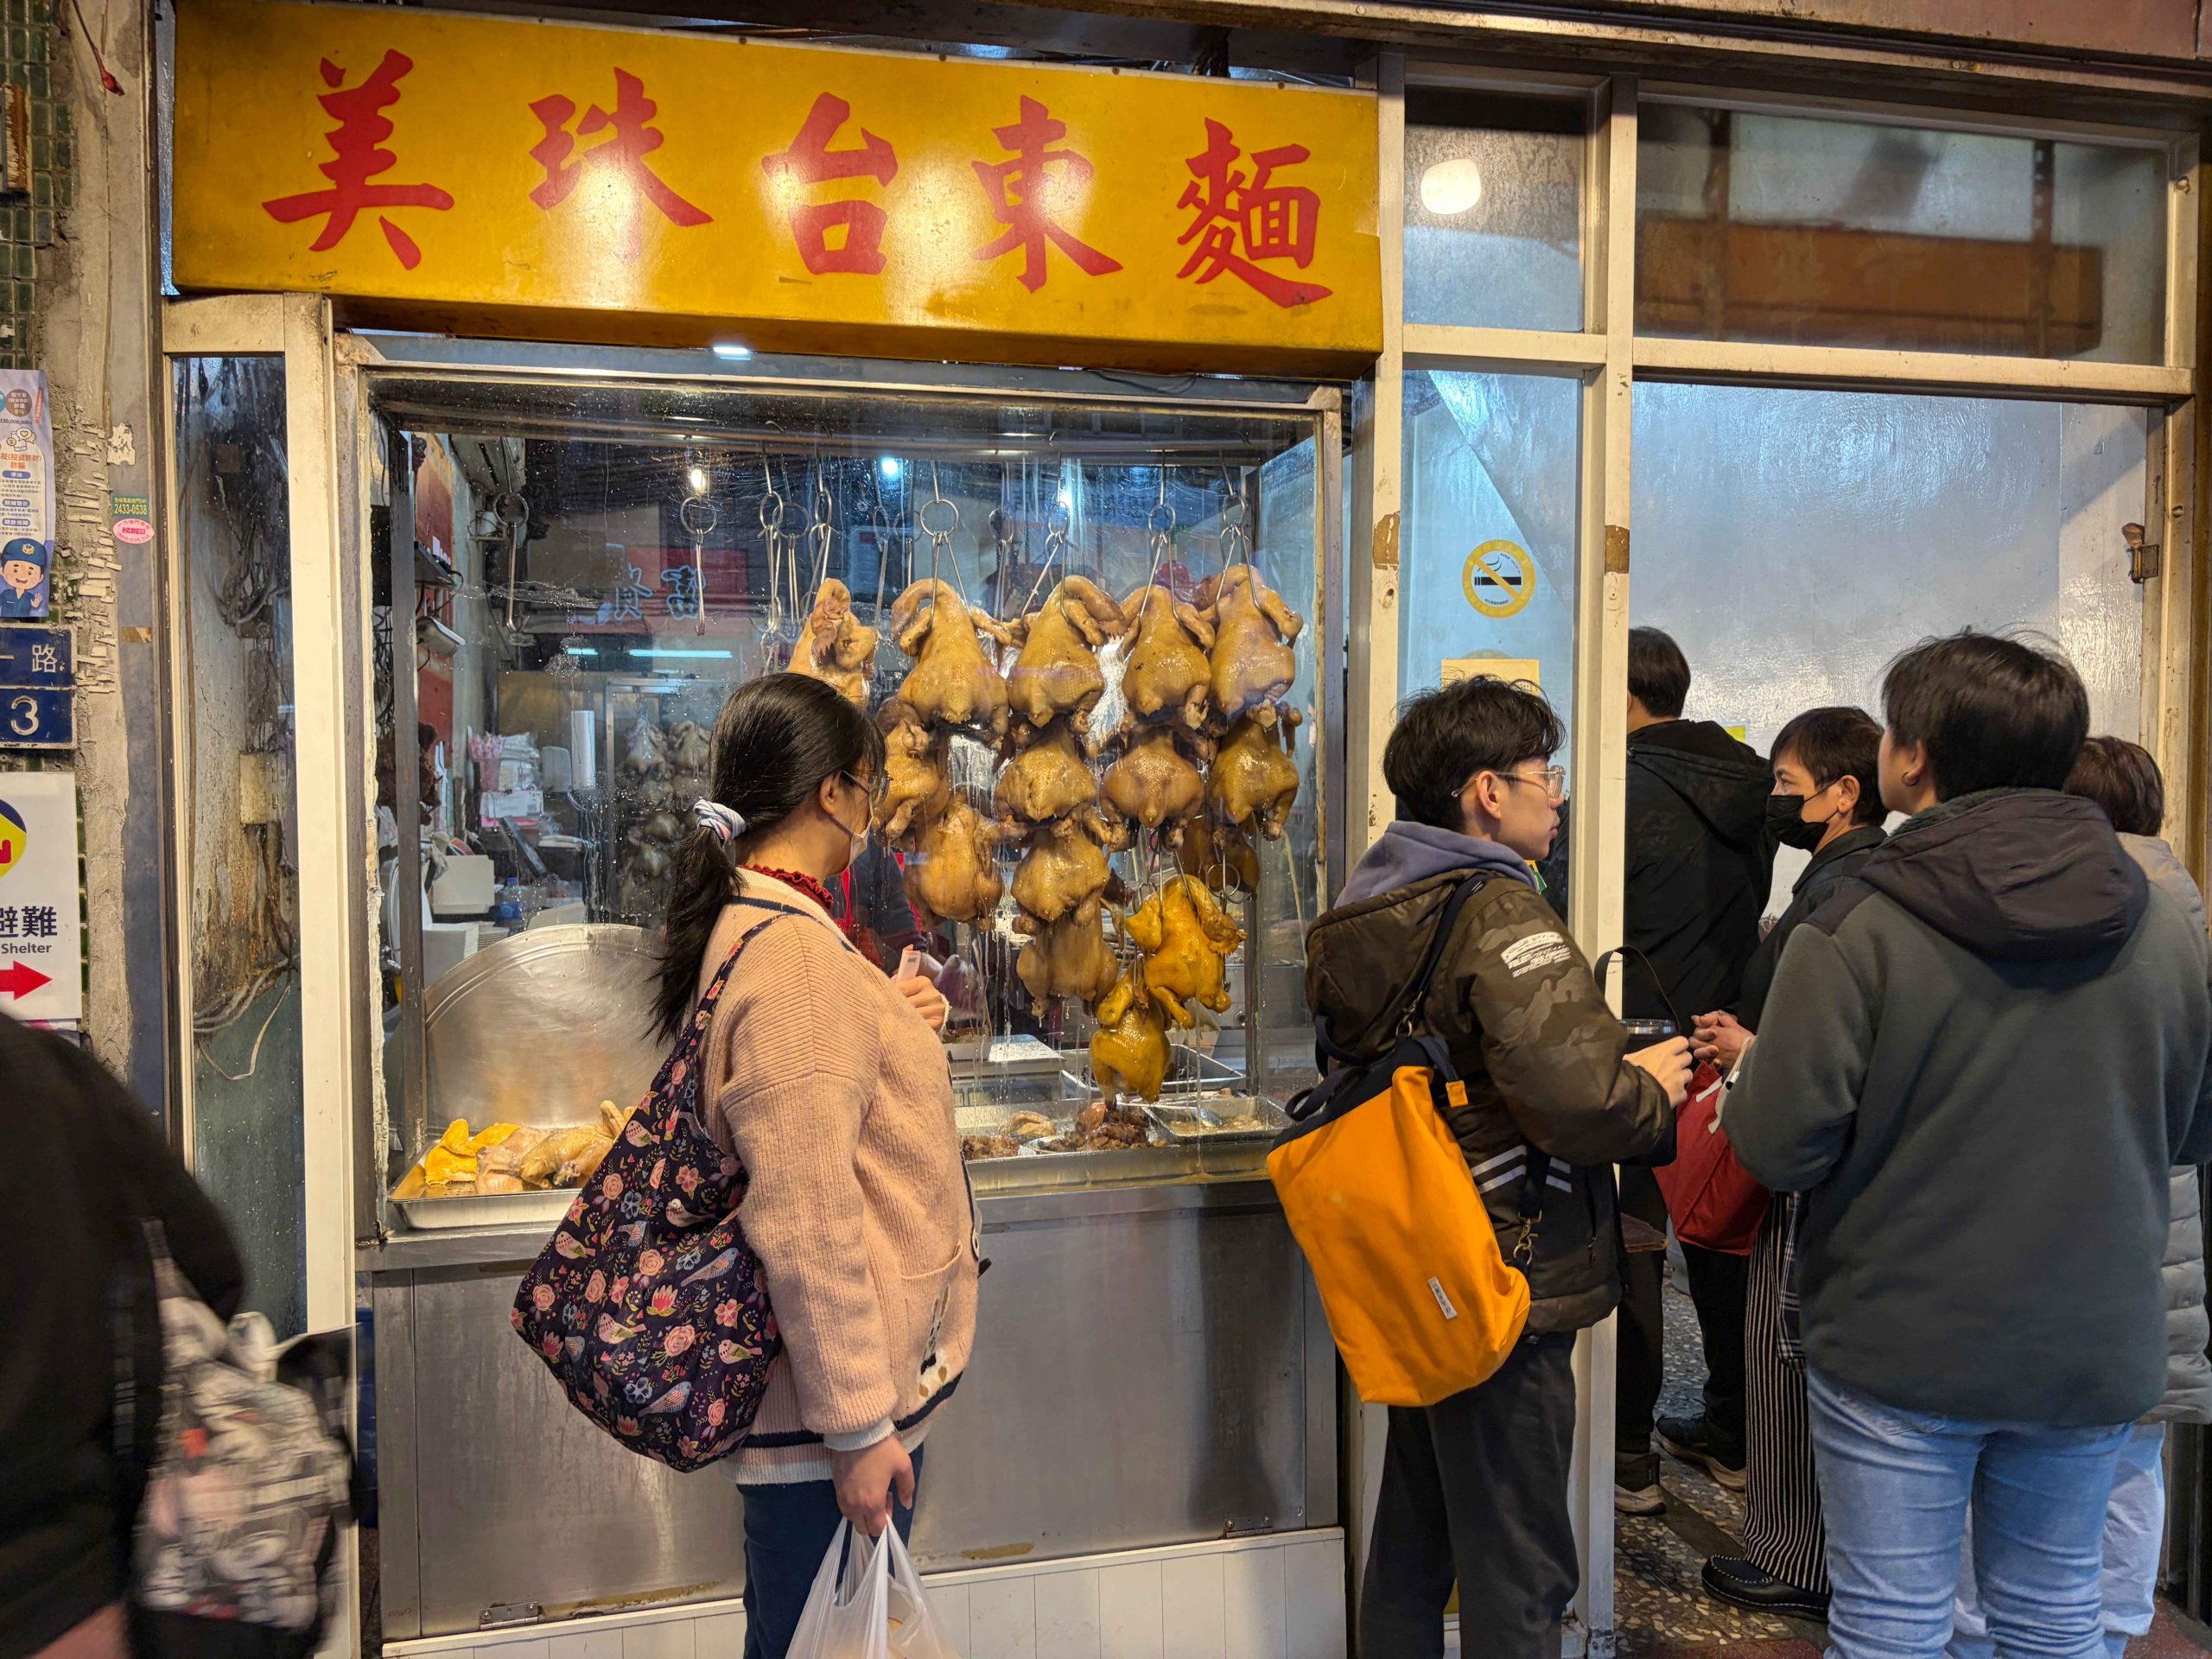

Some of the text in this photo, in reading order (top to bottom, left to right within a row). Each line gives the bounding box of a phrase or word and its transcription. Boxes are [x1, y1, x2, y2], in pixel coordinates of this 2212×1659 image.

[262, 48, 1333, 309] 美珠台東麵
[1, 942, 52, 954] Shelter
